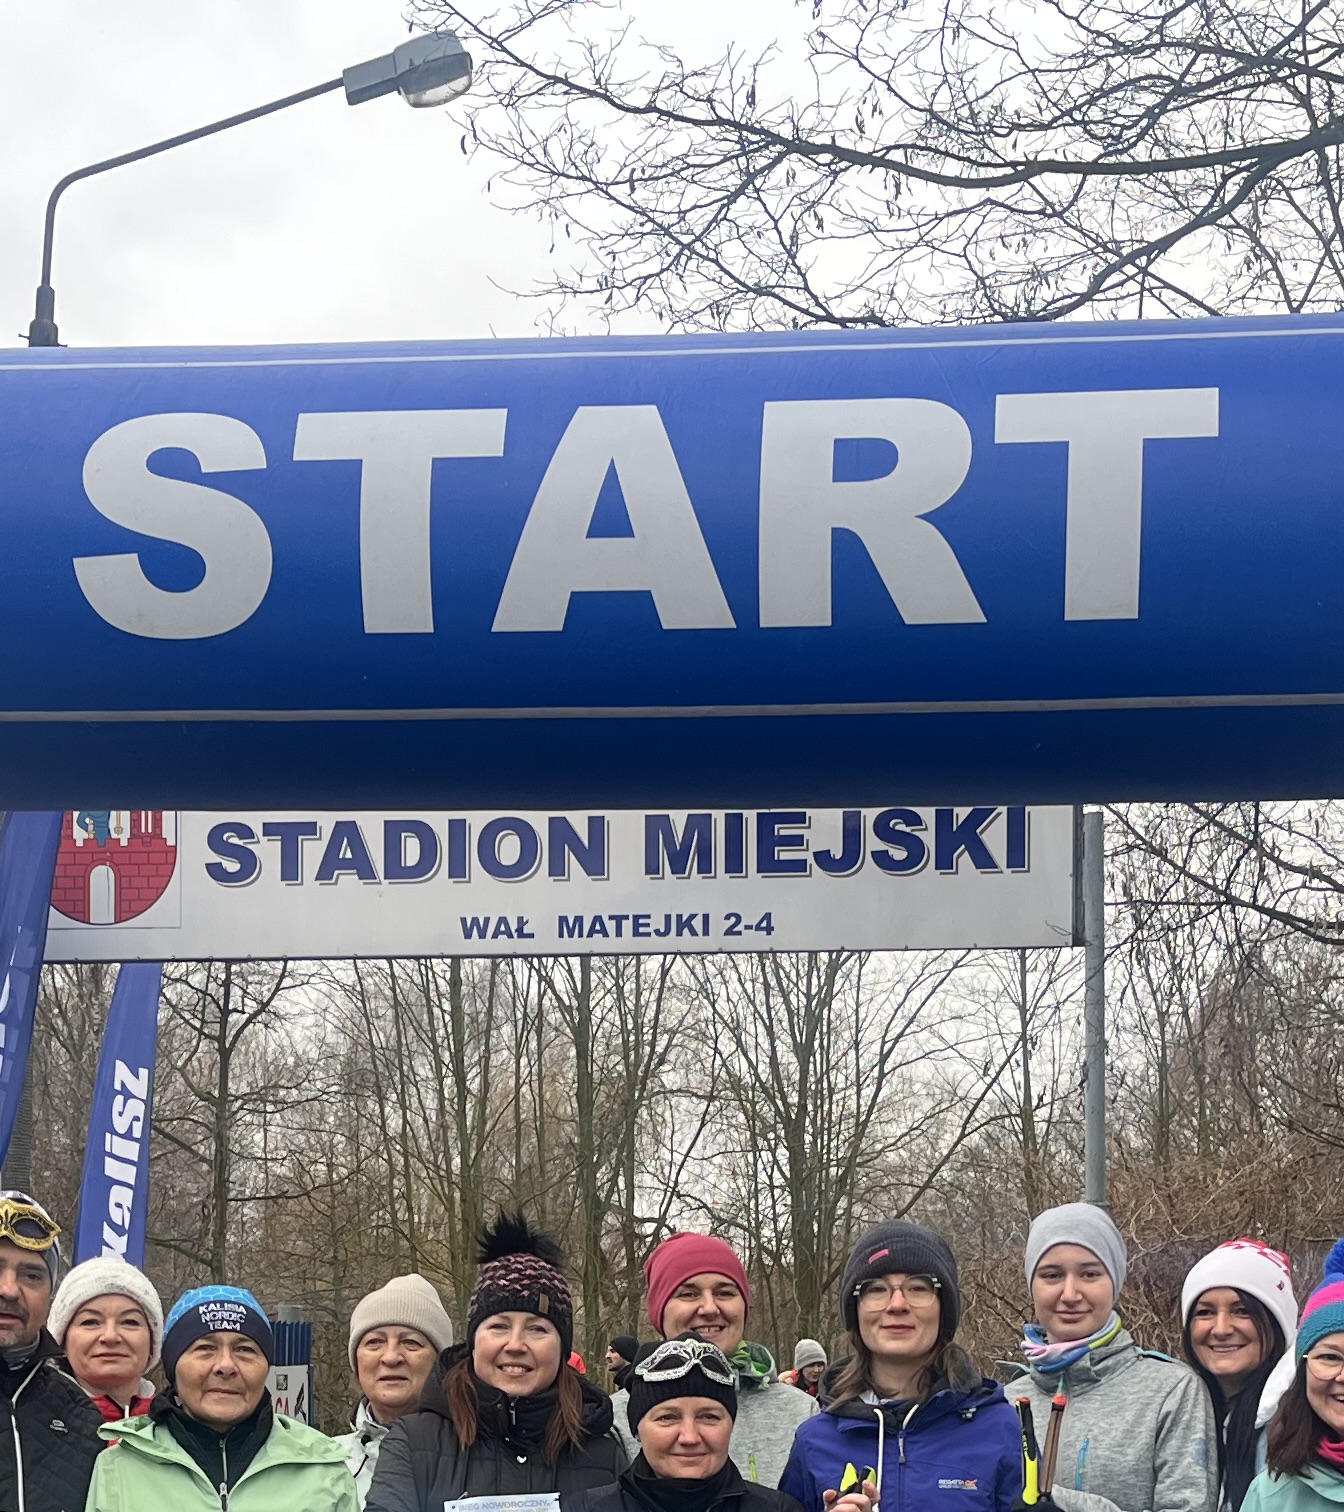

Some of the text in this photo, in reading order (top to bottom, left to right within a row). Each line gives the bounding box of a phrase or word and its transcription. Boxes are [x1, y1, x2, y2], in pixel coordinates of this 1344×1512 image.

[72, 387, 1220, 640] START
[205, 805, 1032, 885] STADION MIEJSKI
[459, 912, 776, 941] WAŁ MATEJKI 2-4
[198, 1302, 248, 1315] KALISIA
[201, 1310, 246, 1324] NORDIC
[207, 1320, 241, 1331] TEAM
